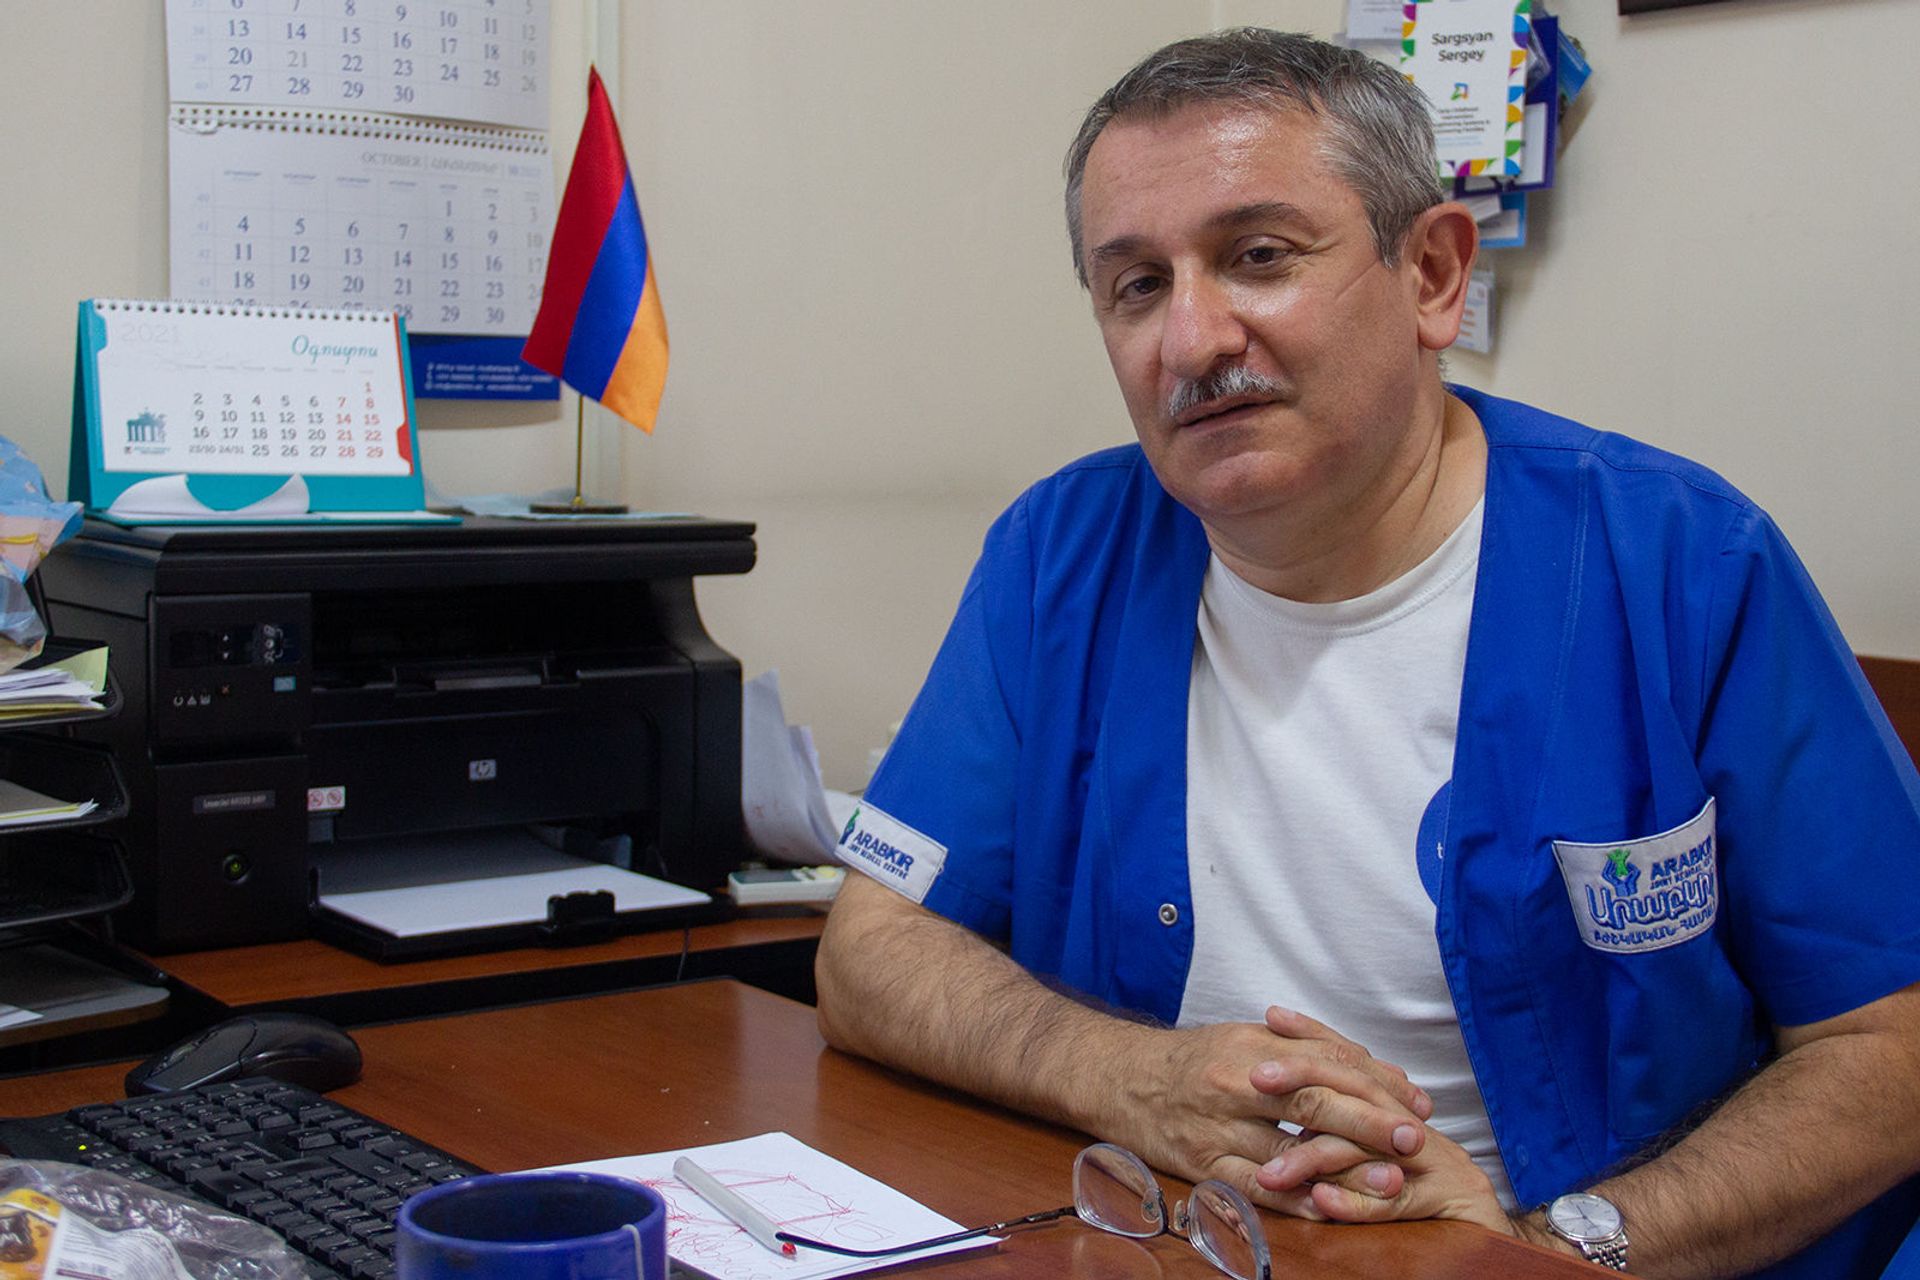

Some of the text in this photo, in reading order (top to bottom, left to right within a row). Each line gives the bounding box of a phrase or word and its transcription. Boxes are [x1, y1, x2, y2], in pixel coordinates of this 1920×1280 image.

[344, 0, 356, 17] 8
[395, 4, 408, 22] 9
[440, 10, 458, 28] 10
[484, 17, 498, 35] 11
[228, 18, 250, 38] 13
[286, 22, 308, 41] 14
[342, 26, 362, 45] 15
[393, 31, 412, 50] 16
[440, 37, 458, 54] 17
[484, 43, 500, 61] 18
[1431, 30, 1493, 46] Sargsyan
[228, 46, 253, 66] 20
[287, 49, 308, 68] 21
[341, 53, 363, 73] 22
[393, 57, 414, 77] 23
[440, 63, 460, 82] 24
[483, 68, 500, 87] 25
[1438, 49, 1485, 63] Sergey
[229, 73, 254, 93] 27
[287, 76, 311, 96] 28
[342, 79, 365, 99] 29
[393, 84, 415, 103] 30
[361, 151, 422, 168] OCTOBER
[445, 199, 452, 218] 1
[487, 202, 498, 221] 2
[236, 215, 250, 233] 4
[294, 217, 306, 236] 5
[346, 220, 360, 238] 6
[398, 222, 409, 240] 7
[444, 226, 455, 243] 8
[487, 228, 499, 245] 9
[234, 242, 253, 261] 11
[290, 245, 311, 264] 12
[344, 247, 364, 266] 13
[393, 250, 413, 268] 14
[441, 252, 459, 270] 15
[485, 255, 503, 272] 16
[233, 270, 255, 290] 18
[290, 272, 311, 291] 19
[342, 274, 365, 294] 20
[394, 277, 412, 296] 21
[440, 279, 460, 298] 22
[485, 280, 505, 299] 23
[440, 304, 461, 323] 29
[485, 306, 505, 324] 30
[364, 380, 373, 394] 1
[192, 392, 376, 410] 2 3 4 5 6 7 8
[193, 408, 381, 426] 9 10 11 12 13 14 15
[192, 425, 383, 443] 16 17 18 19 20 21 22
[251, 443, 271, 458] 25
[280, 444, 300, 458] 26
[309, 444, 328, 458] 27
[337, 445, 356, 458] 28
[366, 446, 384, 459] 29
[853, 829, 914, 872] ARABKIR
[1651, 834, 1712, 880] ARABKI
